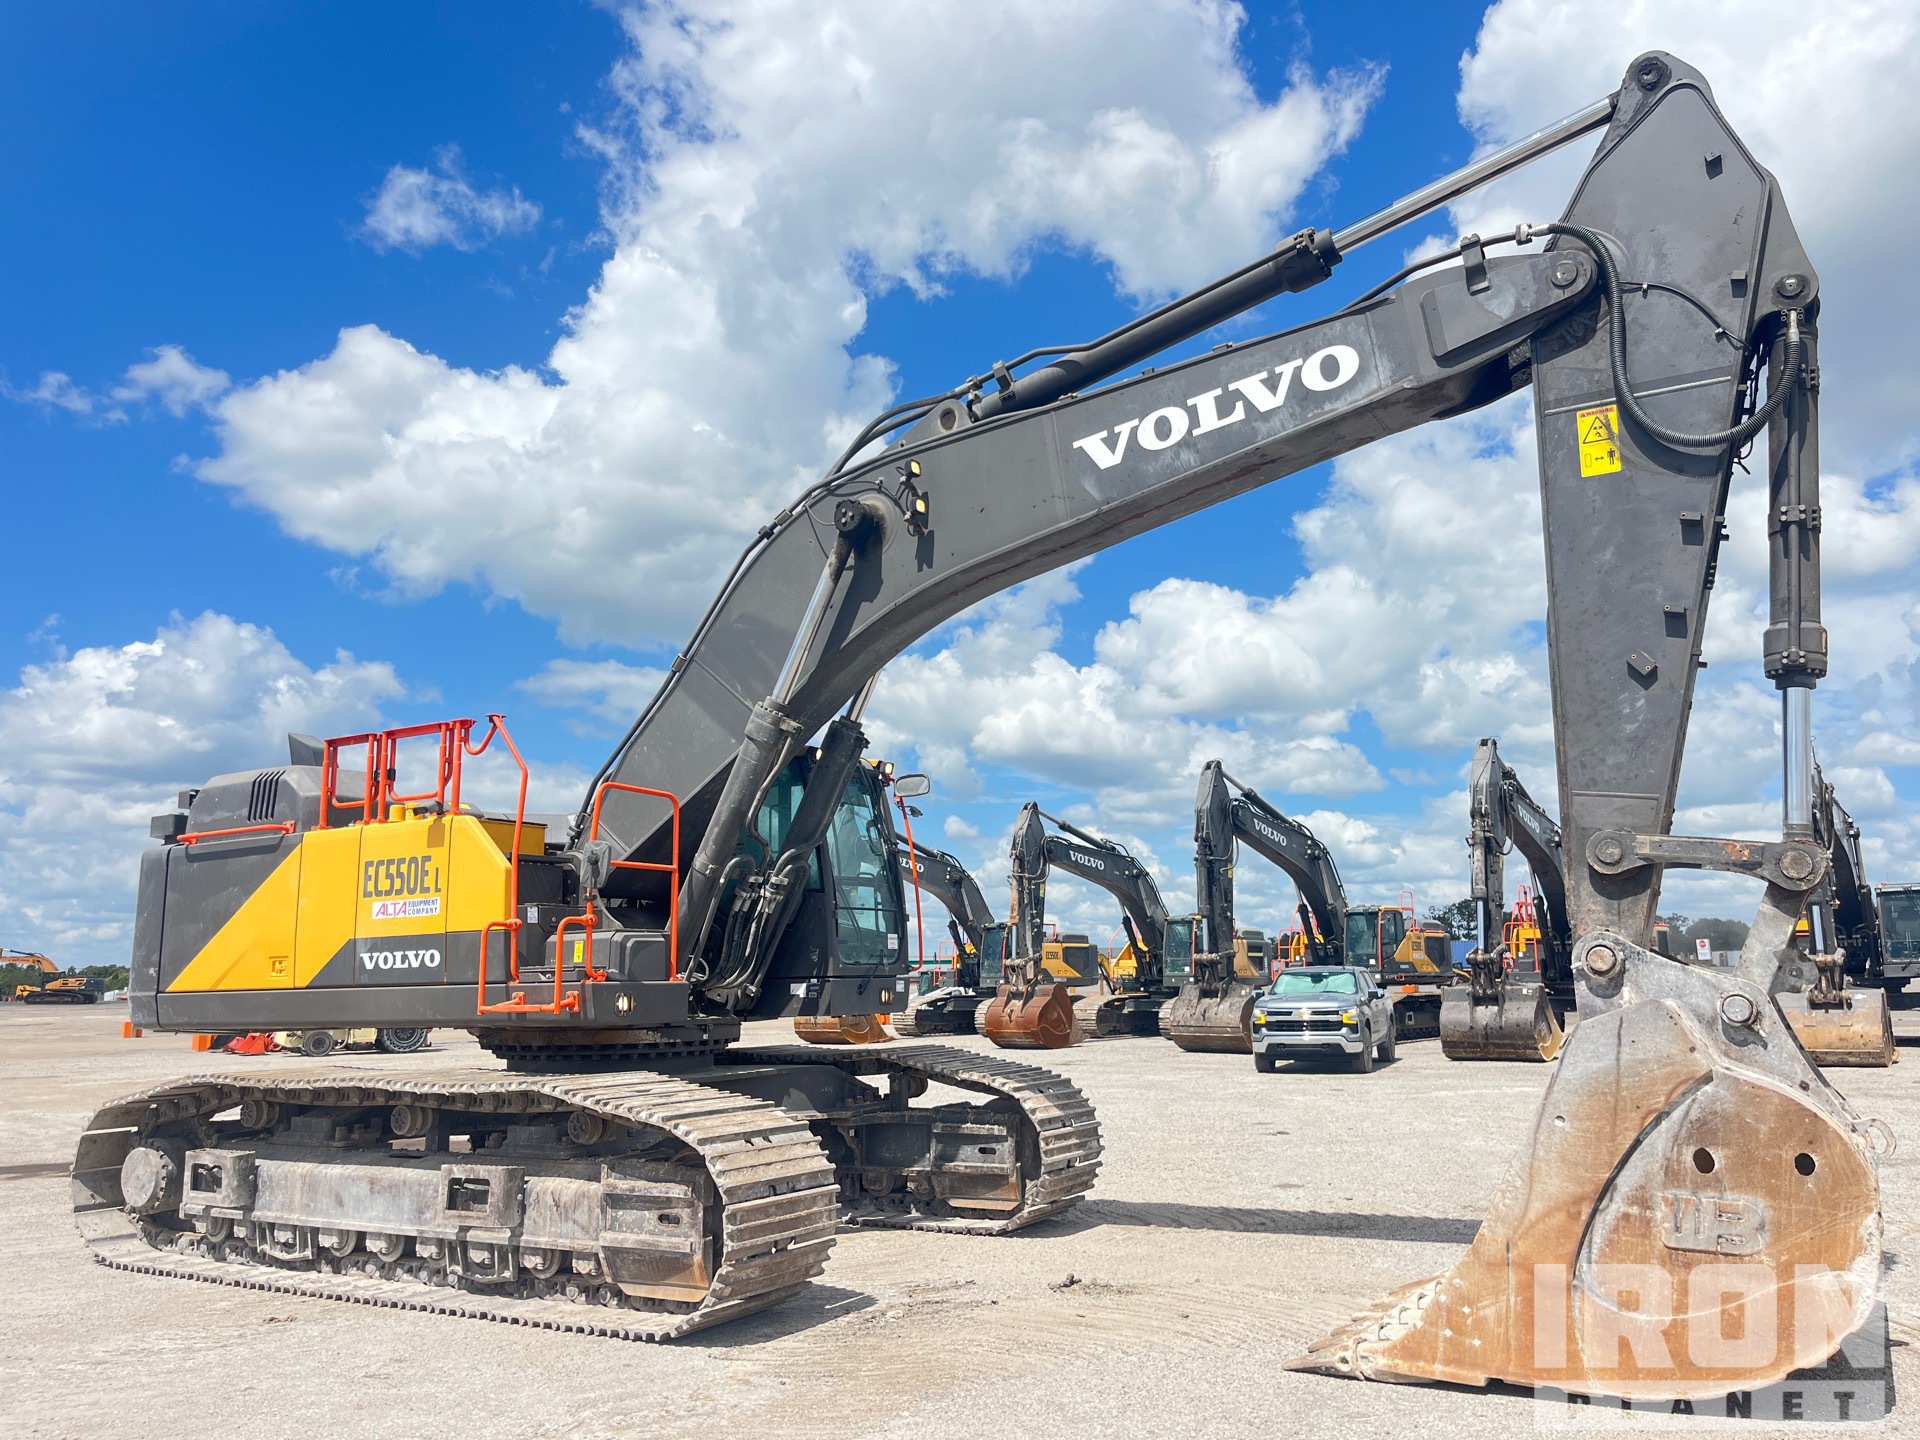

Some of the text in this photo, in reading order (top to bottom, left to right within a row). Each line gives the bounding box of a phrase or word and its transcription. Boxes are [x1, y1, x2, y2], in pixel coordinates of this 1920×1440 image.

[1072, 344, 1360, 470] VOLVO
[1586, 406, 1615, 417] WARNING
[1517, 803, 1540, 834] VOLVO
[1253, 818, 1287, 847] VOLVO
[1069, 850, 1105, 871] VOLVO
[363, 855, 432, 898] EC550E
[375, 900, 407, 917] ALTA
[407, 898, 439, 908] EQUIPMENT
[407, 906, 438, 916] COMPANY
[360, 949, 441, 970] VOLVO
